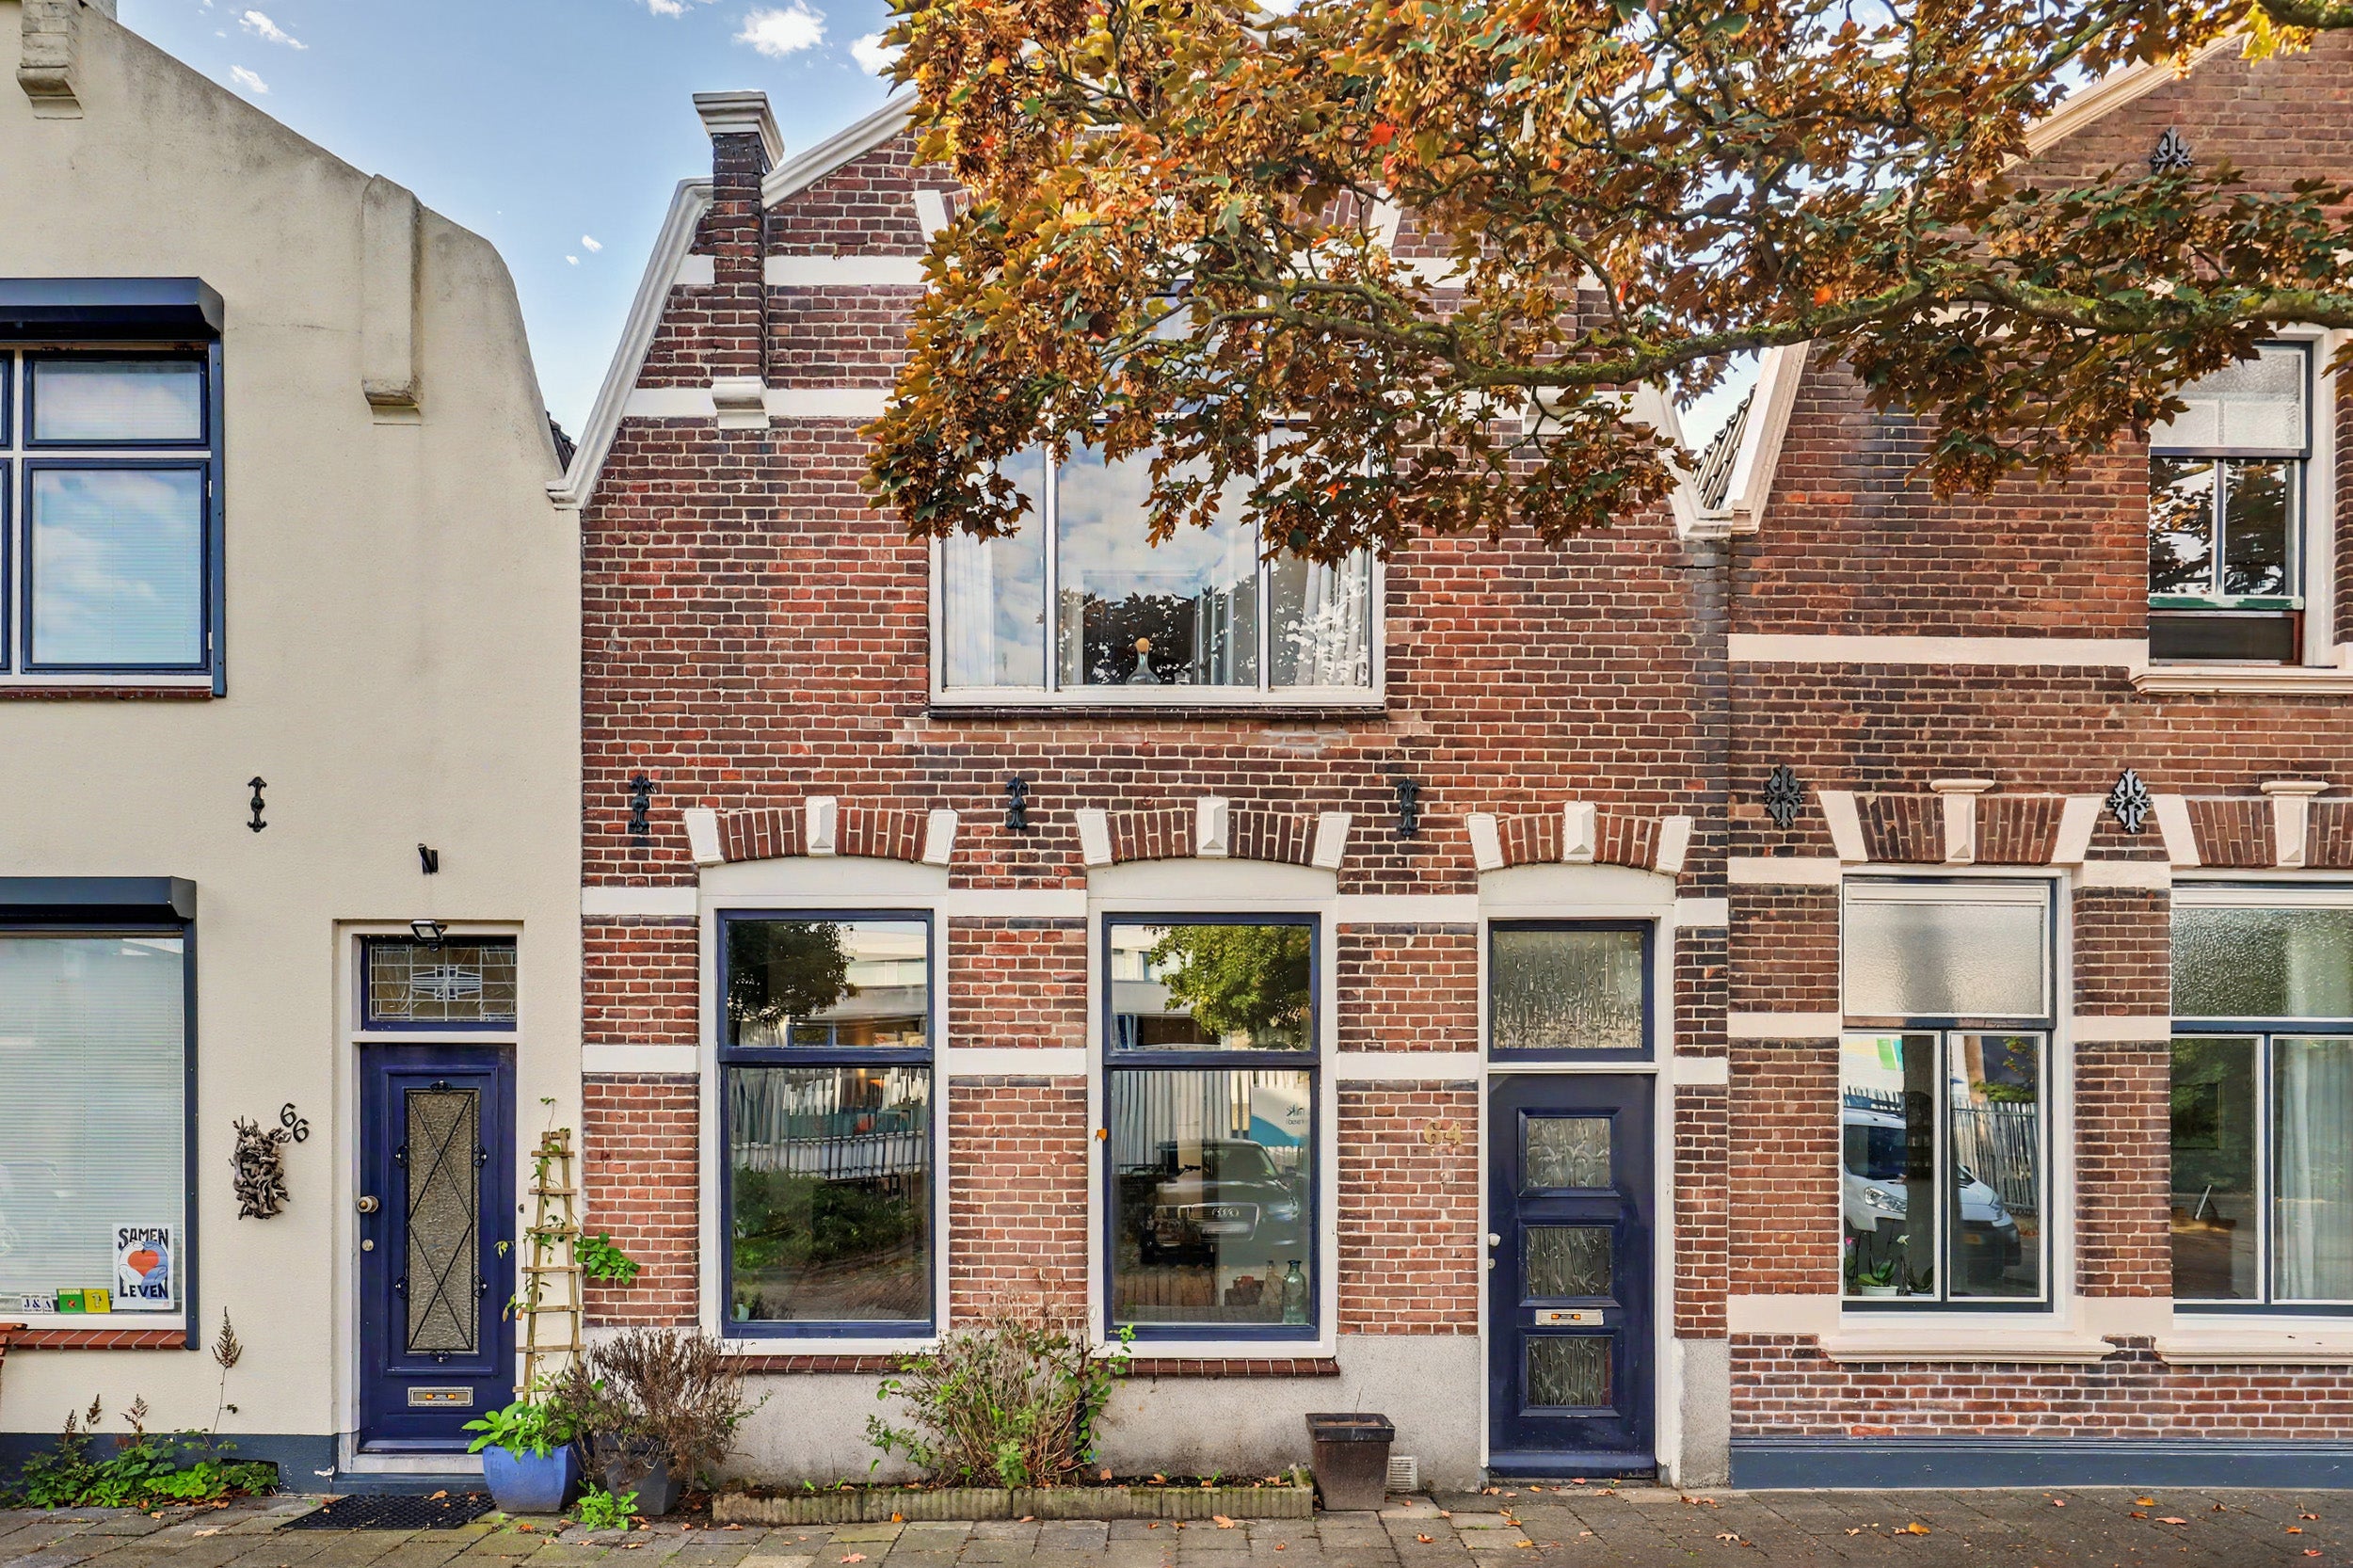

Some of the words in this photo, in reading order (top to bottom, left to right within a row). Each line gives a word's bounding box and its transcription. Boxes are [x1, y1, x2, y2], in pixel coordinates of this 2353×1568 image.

[280, 1102, 310, 1143] 66
[1423, 1121, 1464, 1144] 64
[118, 1227, 168, 1252] SAMEN
[119, 1275, 168, 1299] LEVEN
